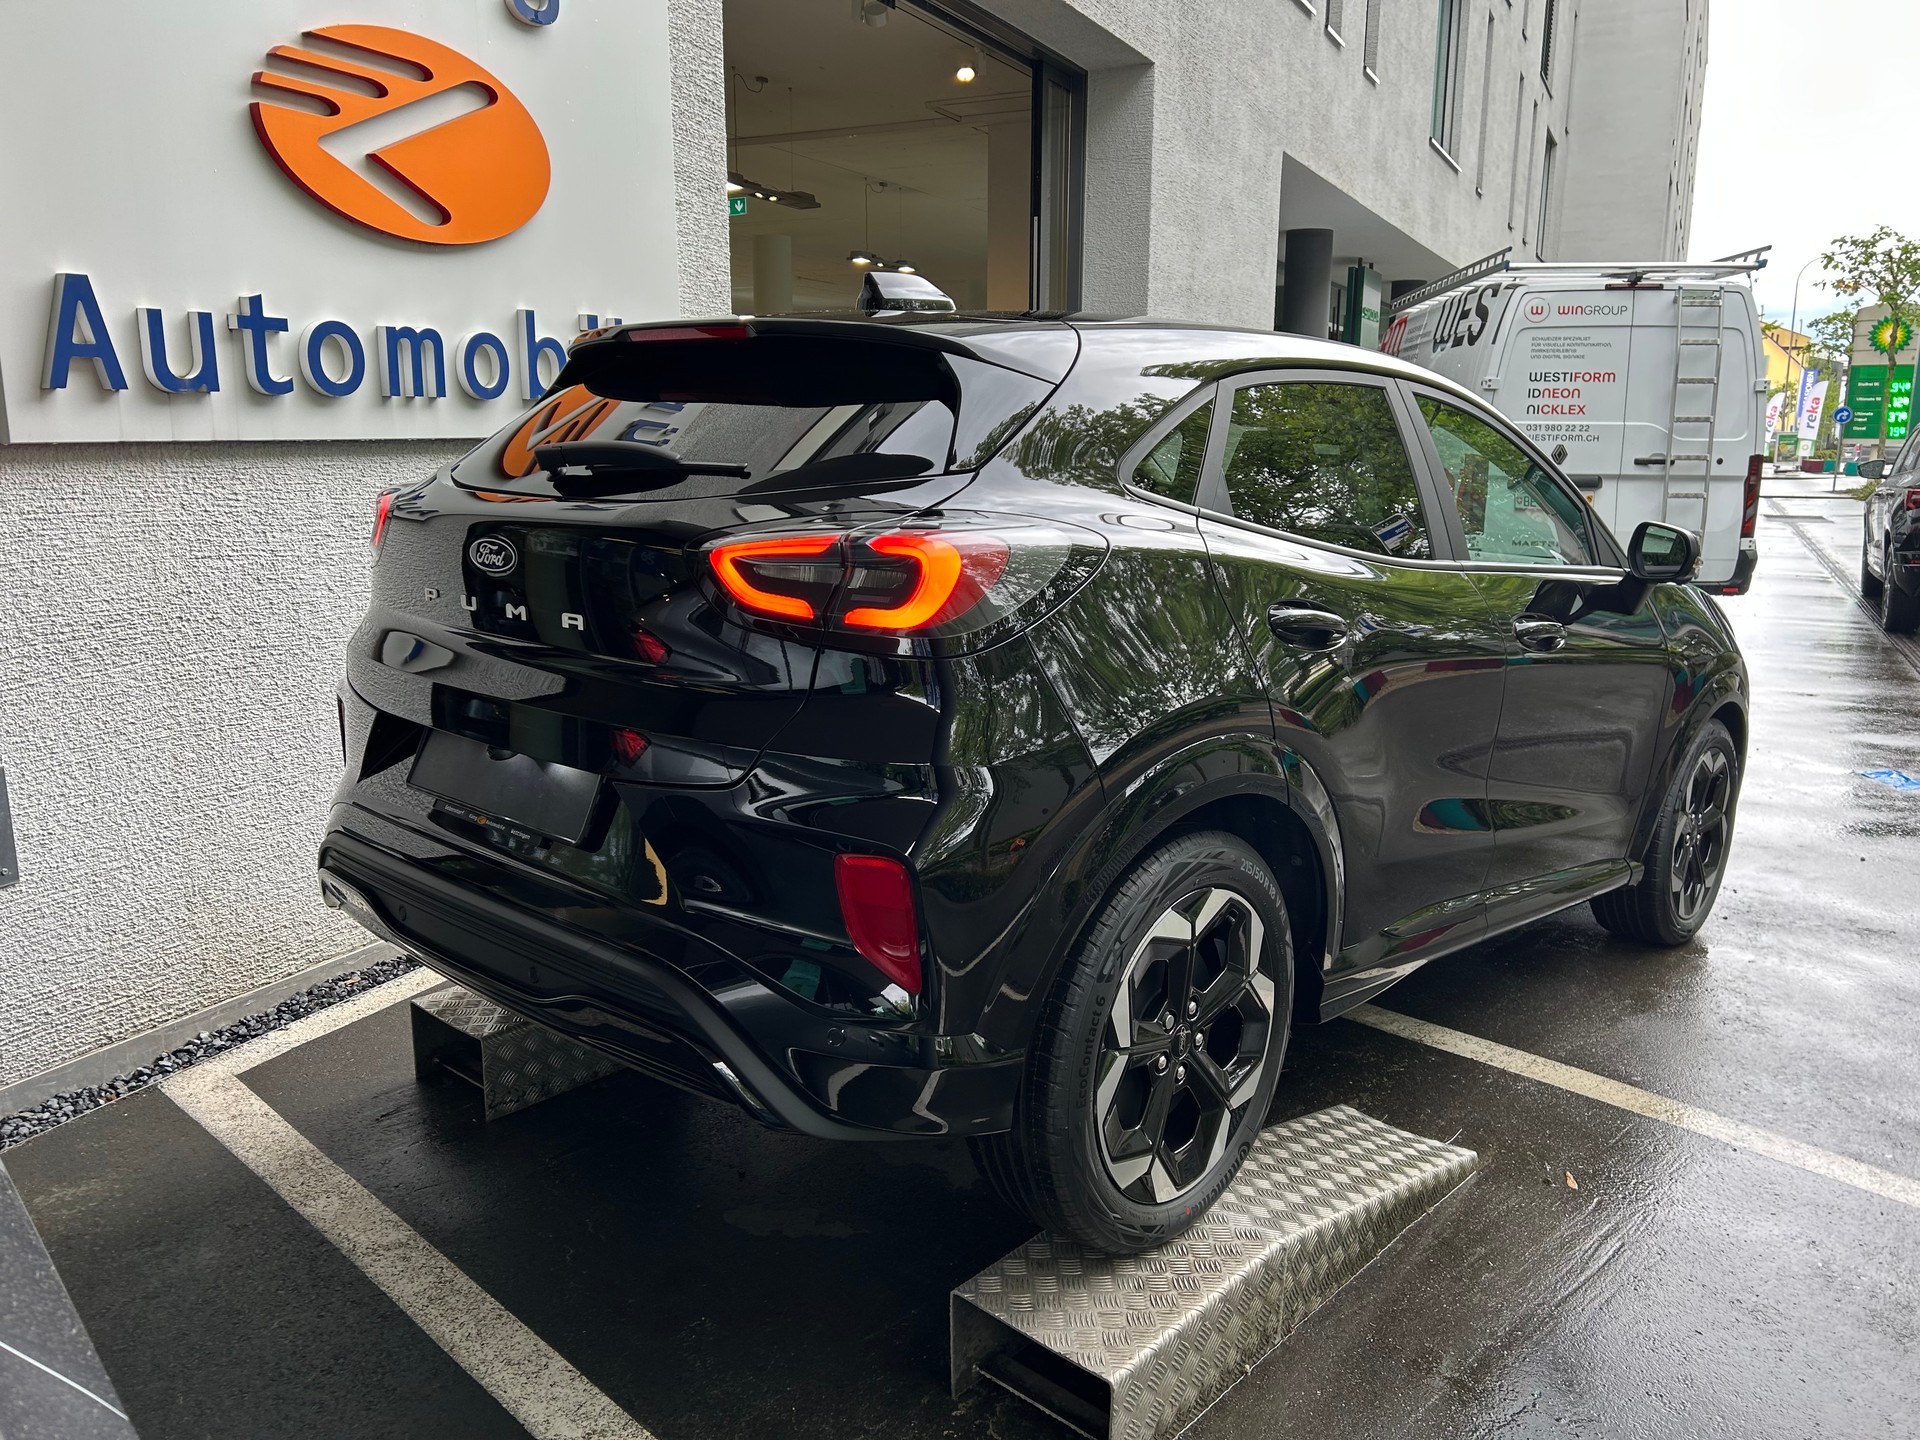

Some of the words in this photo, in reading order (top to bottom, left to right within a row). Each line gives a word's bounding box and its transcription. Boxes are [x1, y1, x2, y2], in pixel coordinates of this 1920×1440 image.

[1557, 305, 1628, 315] WINGROUP
[42, 272, 622, 400] Automob
[1529, 372, 1616, 382] WESTIFORM
[1527, 388, 1581, 399] IDNEON
[1526, 404, 1586, 415] NICKLEX
[1806, 397, 1821, 429] reka
[1526, 424, 1541, 432] 031
[1544, 424, 1562, 432] 980
[1565, 424, 1576, 432] 22
[1766, 405, 1778, 433] reka
[1511, 540, 1559, 548] MASTE
[424, 588, 584, 631] PUMA
[1240, 858, 1265, 884] 215/50
[1075, 1007, 1103, 1110] EcoContact
